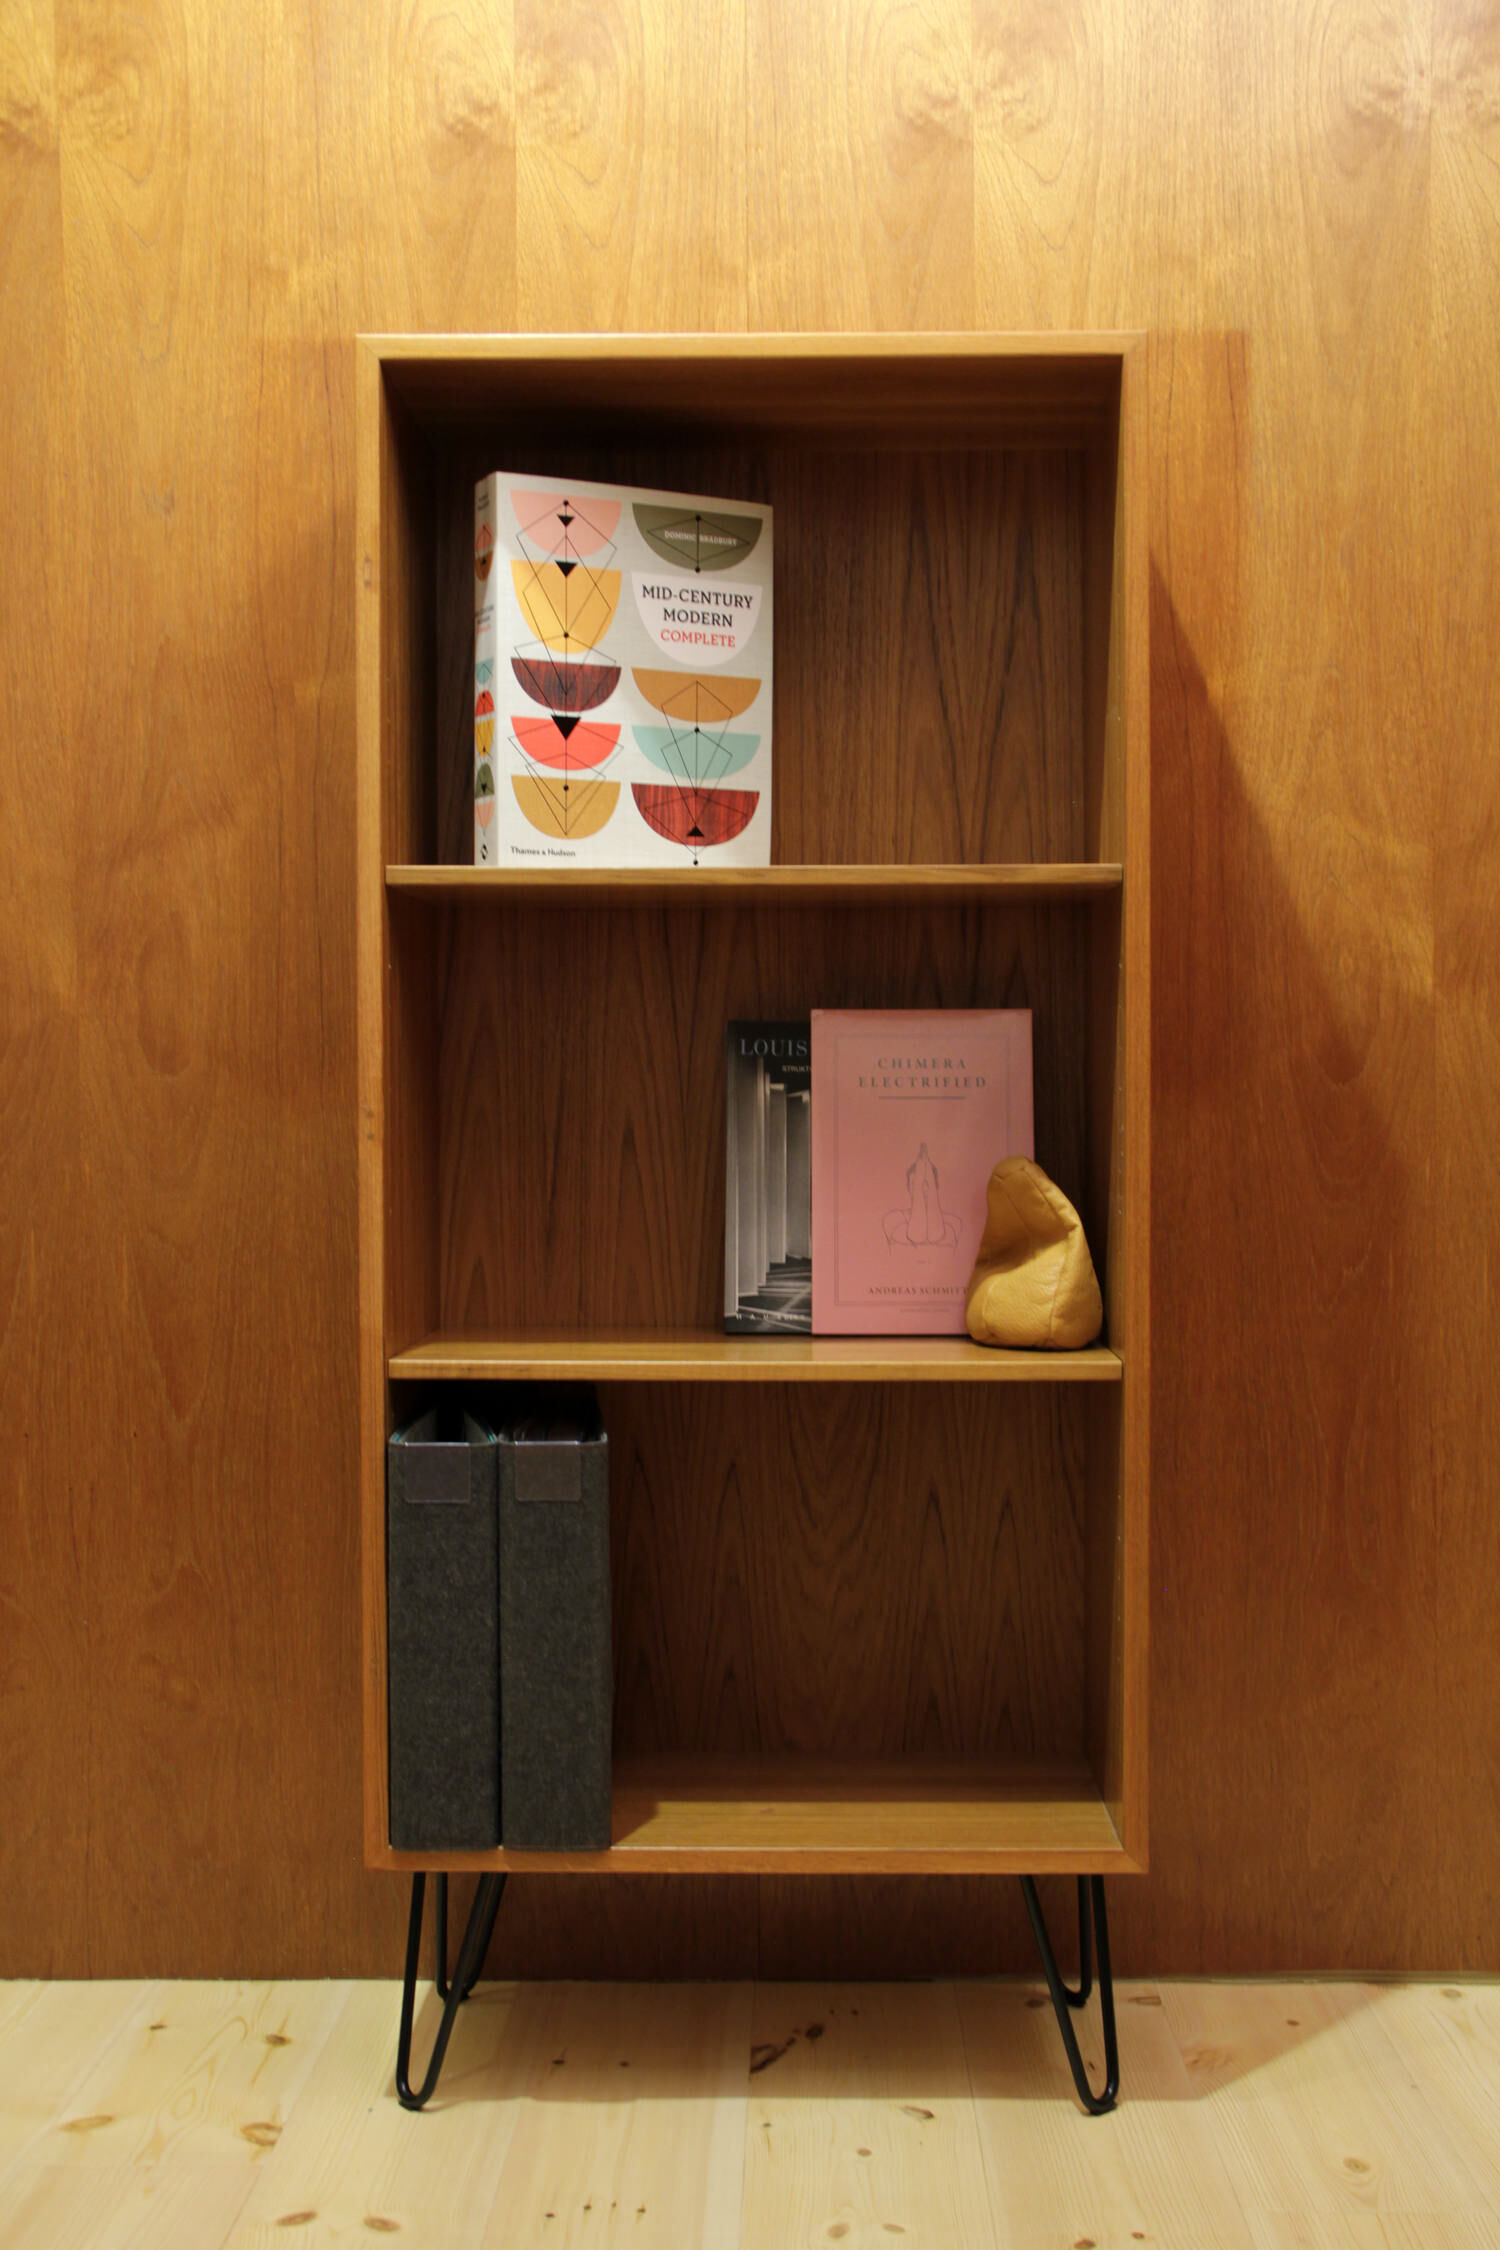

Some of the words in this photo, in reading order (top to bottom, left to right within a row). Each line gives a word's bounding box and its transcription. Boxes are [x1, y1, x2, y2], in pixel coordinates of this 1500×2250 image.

[642, 584, 753, 609] MID-CENTURY
[663, 607, 733, 627] MODERN
[660, 628, 736, 648] COMPLETE
[510, 845, 541, 856] Thames
[547, 847, 576, 857] Hudson
[739, 1038, 808, 1056] LOUIS
[876, 1057, 967, 1069] CHIMERA
[857, 1075, 987, 1088] ELECTRIFIED
[868, 1286, 917, 1295] ANDREAS
